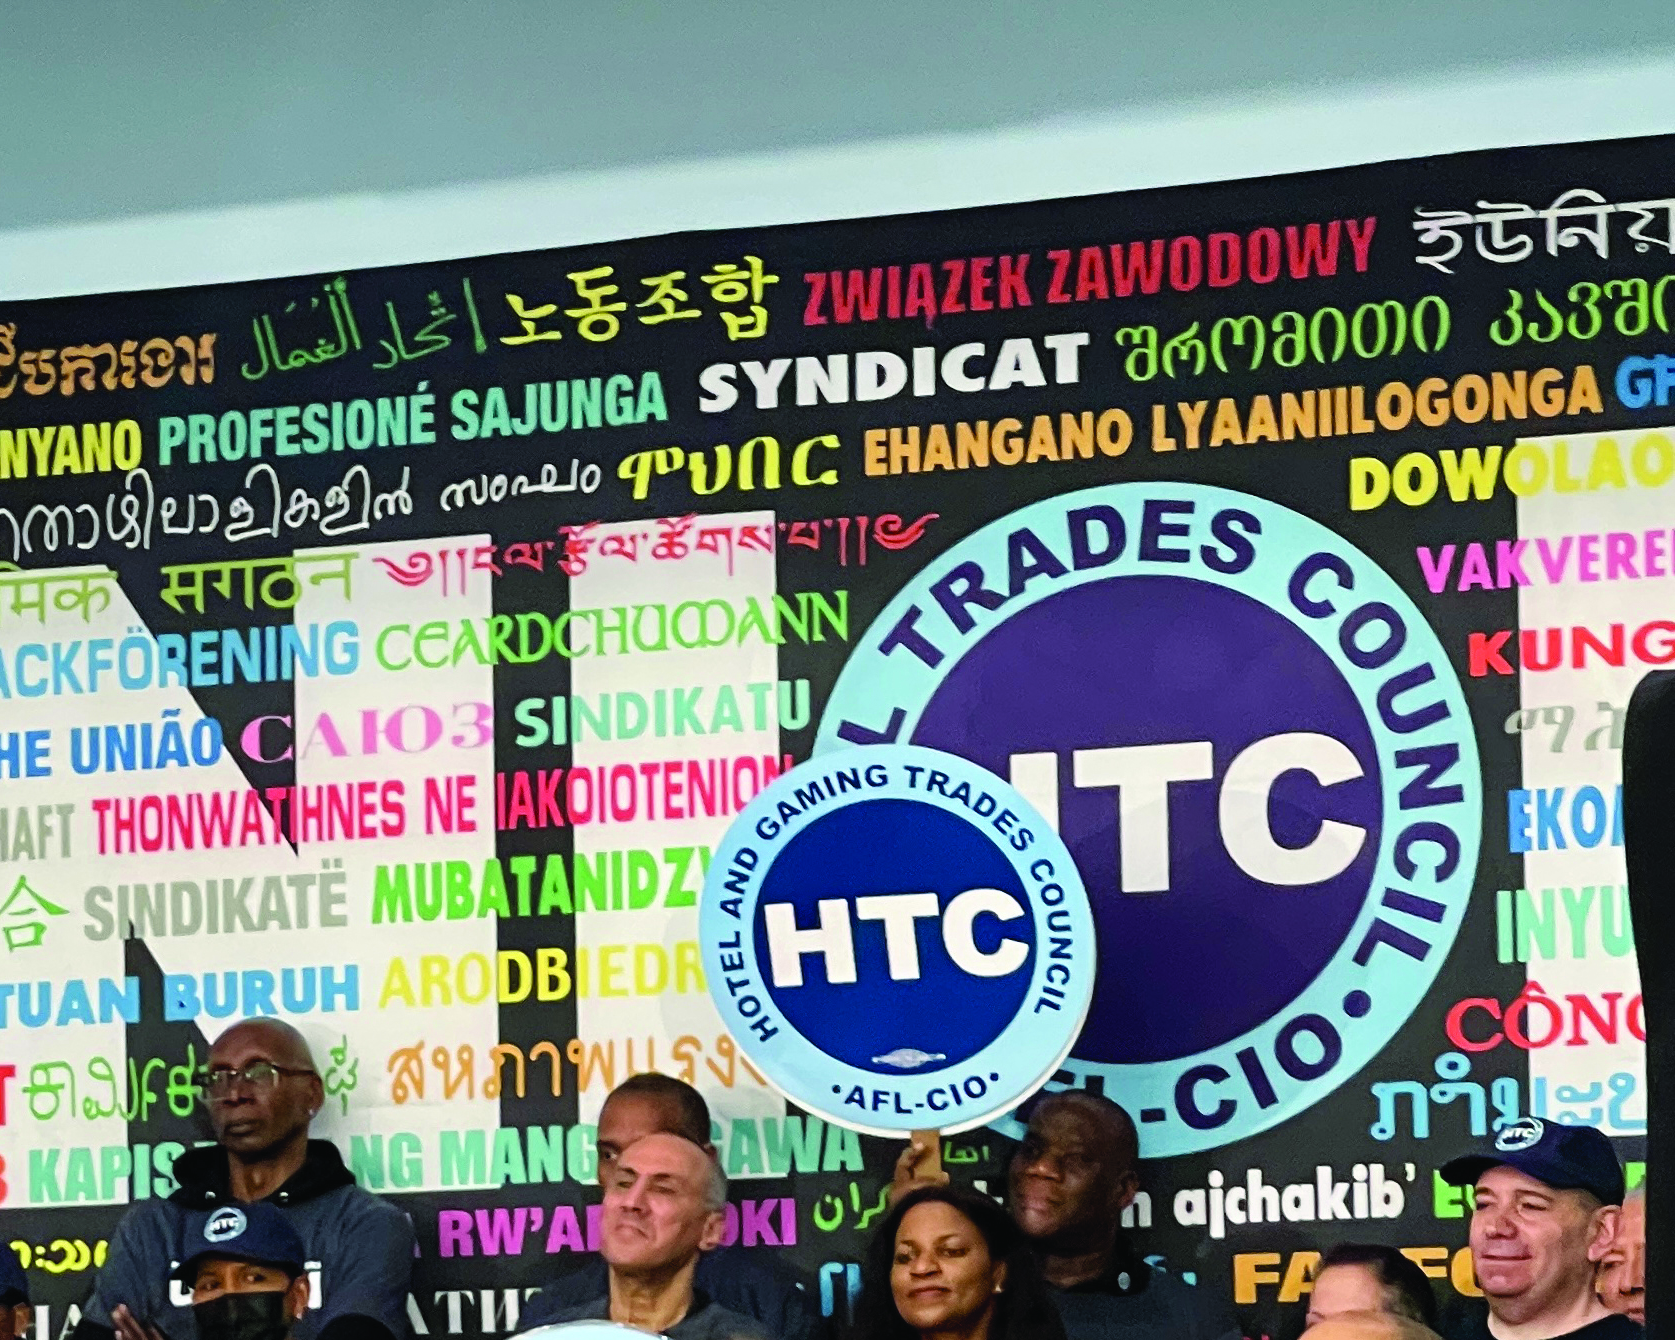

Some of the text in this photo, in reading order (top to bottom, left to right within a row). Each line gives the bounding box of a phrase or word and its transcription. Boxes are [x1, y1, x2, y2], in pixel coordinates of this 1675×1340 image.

[500, 255, 779, 345] 노동조합
[803, 216, 1377, 330] ZWIĄZEK ZAWODOWY
[698, 331, 1090, 414] SYNDICAT
[158, 371, 669, 467] PROFESIONÉ SAJUNGA
[864, 408, 1133, 477] EHANGANO
[1151, 364, 1604, 453] LYAANIILOGONGA
[1349, 432, 1675, 511] DOWOLAO
[1415, 529, 1675, 594] VAKVERE
[70, 708, 224, 776] UNIÃO
[514, 679, 812, 749] SINDIKATU
[878, 498, 1467, 966] TRADES COUNCIL
[424, 774, 478, 836] NE
[83, 858, 348, 942] SINDIKATË
[370, 846, 711, 926] MUBATANIDZ
[719, 764, 1075, 1043] HOTEL AND GAMING TRADES COUNCIL
[763, 887, 1030, 989] HTC
[163, 963, 360, 1022] BURUH
[844, 1074, 989, 1115] AFL-CIO
[350, 1132, 424, 1189] NG
